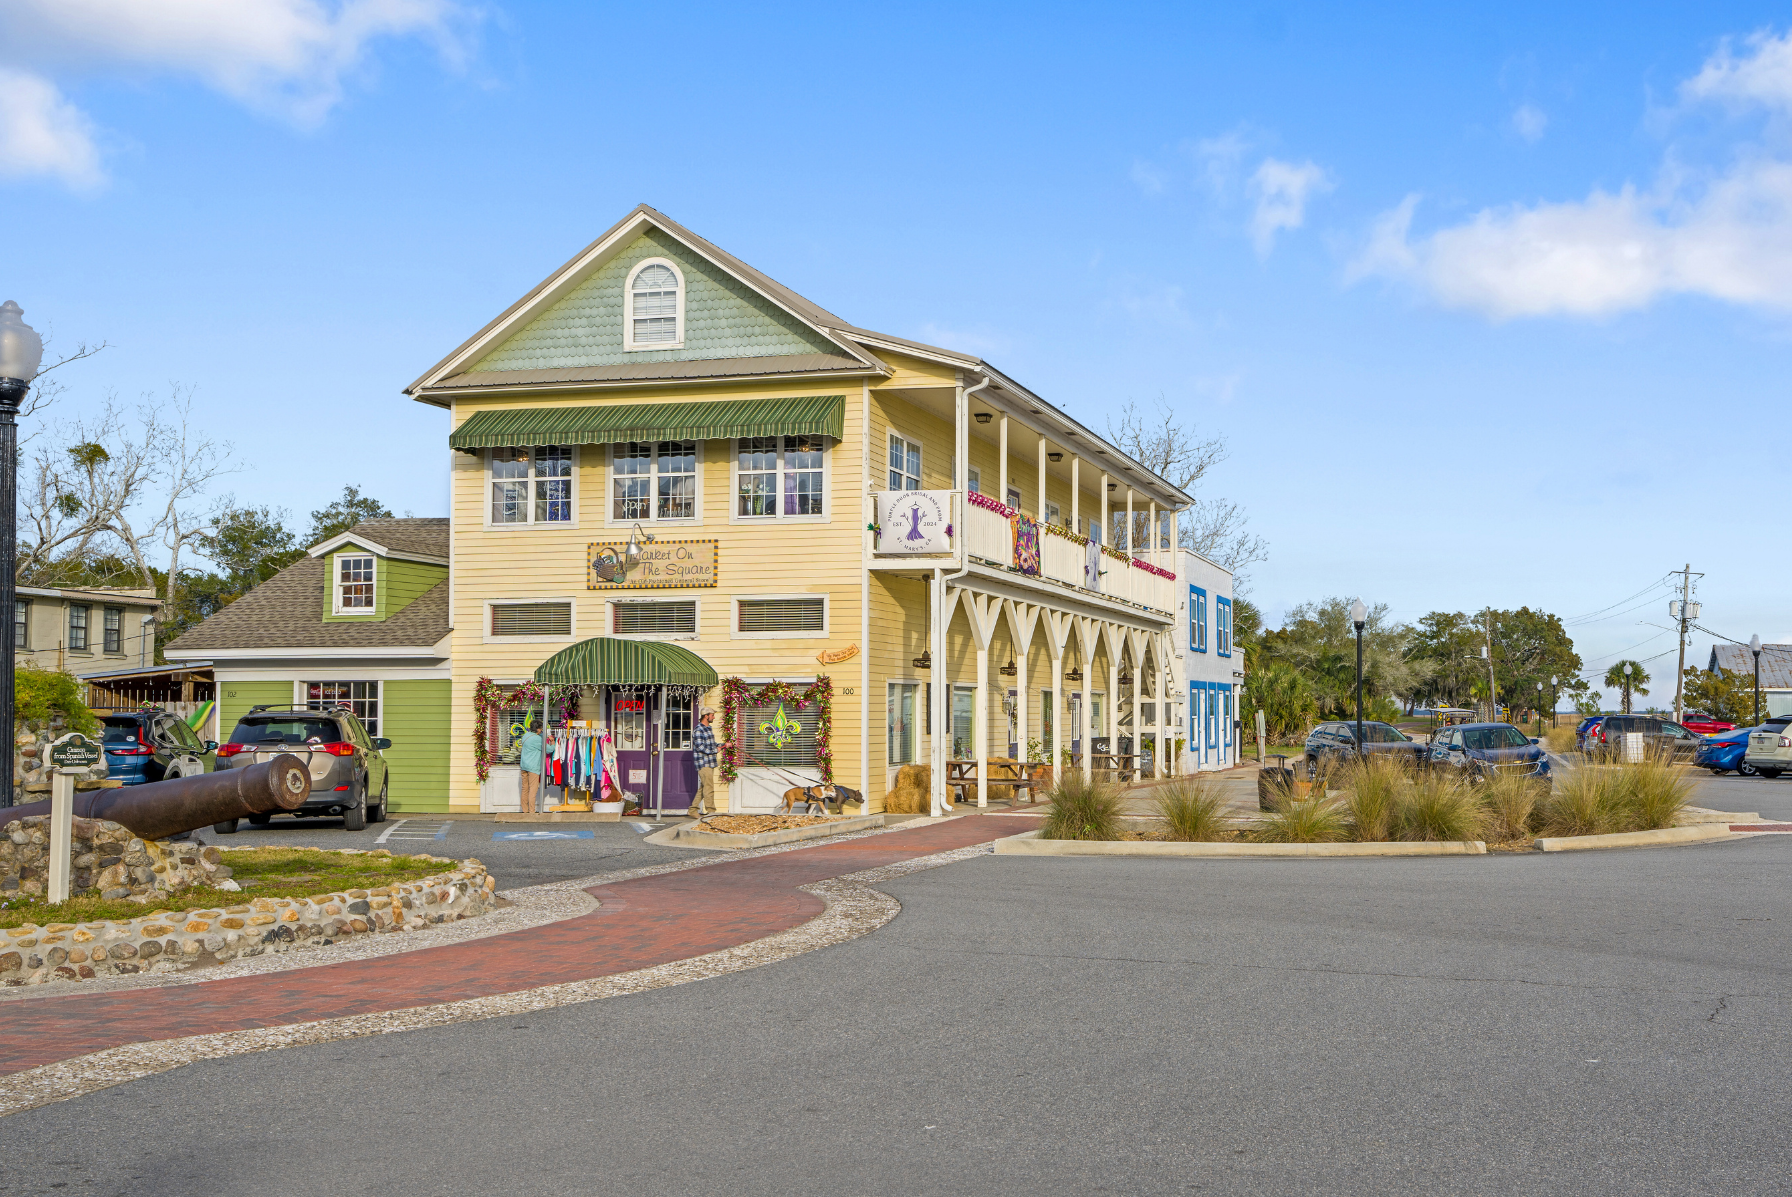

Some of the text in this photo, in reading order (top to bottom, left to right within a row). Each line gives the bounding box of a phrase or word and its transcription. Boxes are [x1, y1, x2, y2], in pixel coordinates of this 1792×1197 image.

[928, 496, 938, 506] AND
[629, 547, 693, 562] Market On
[640, 562, 711, 578] The Square
[842, 687, 855, 695] 100
[616, 700, 645, 712] OPEN
[66, 752, 85, 760] Spanish
